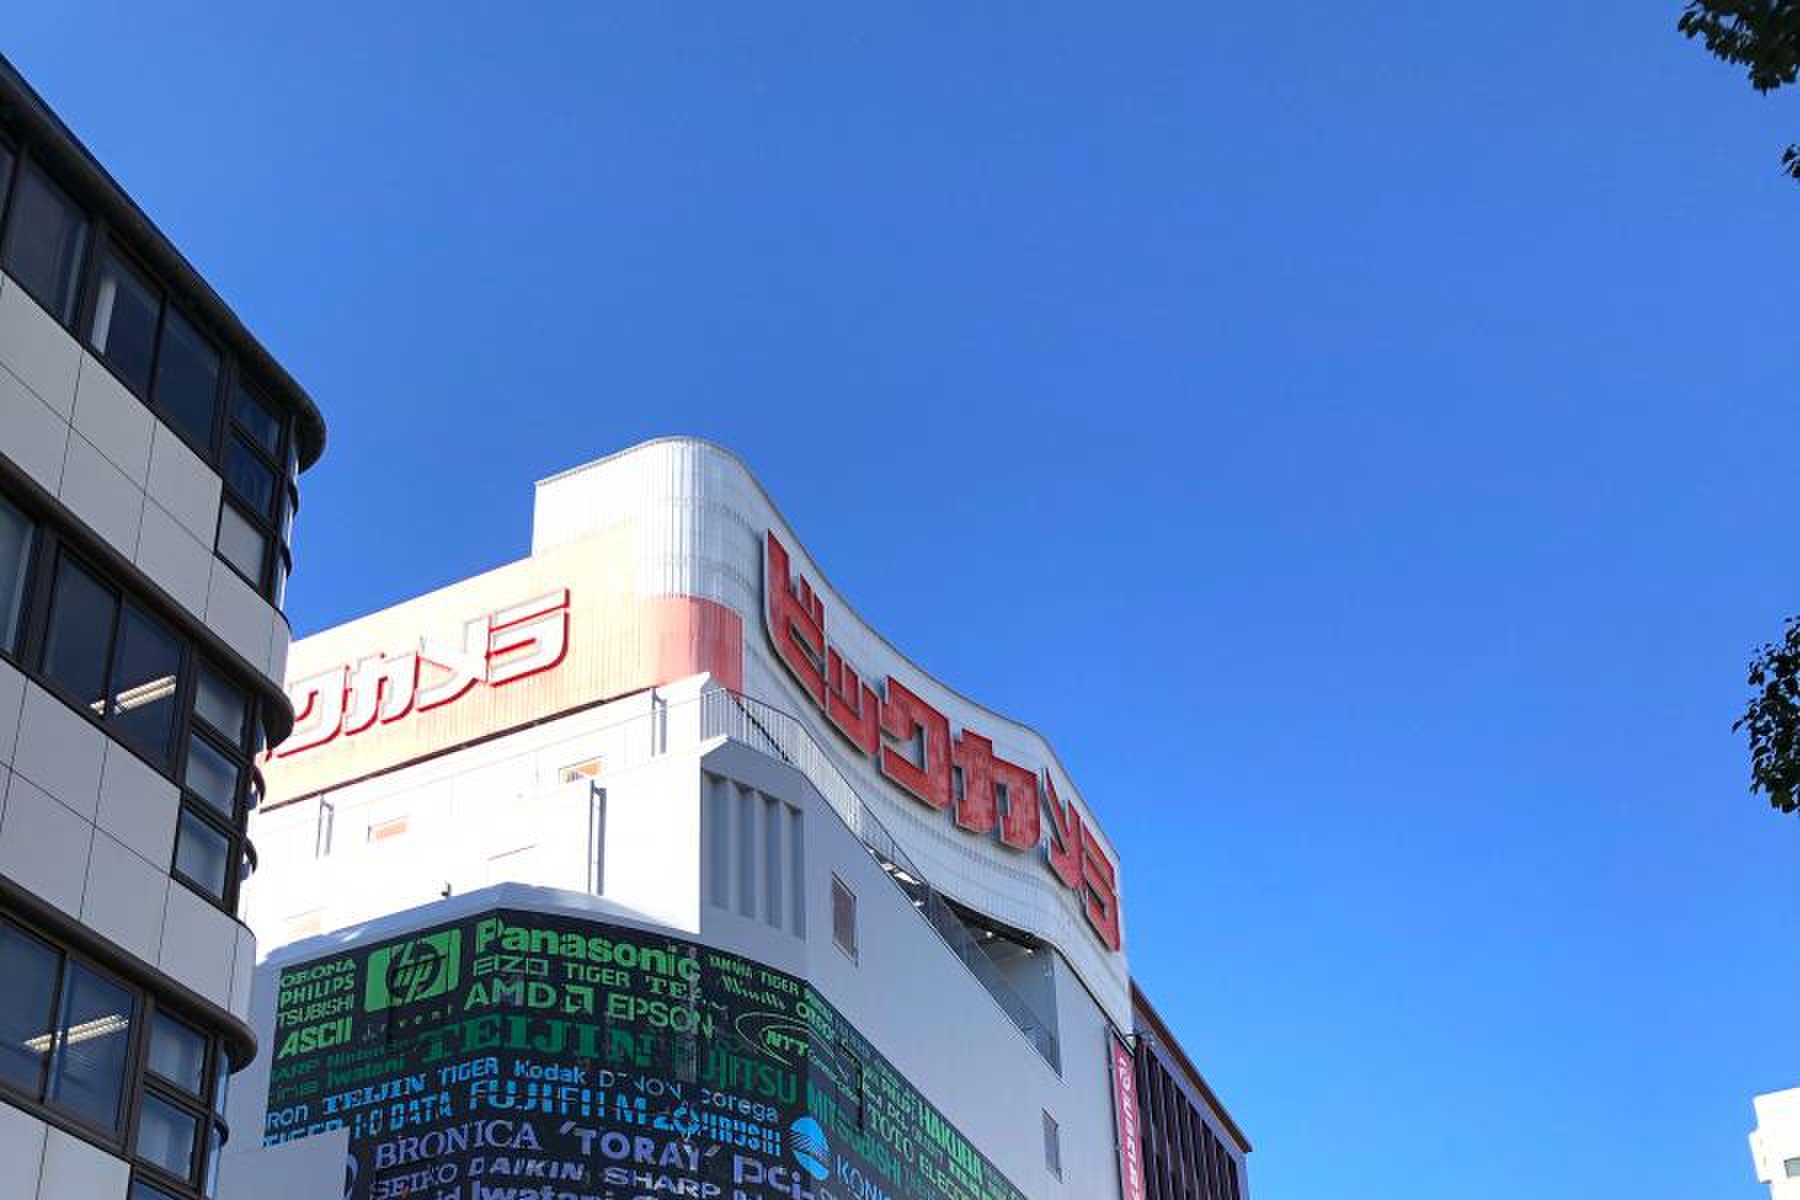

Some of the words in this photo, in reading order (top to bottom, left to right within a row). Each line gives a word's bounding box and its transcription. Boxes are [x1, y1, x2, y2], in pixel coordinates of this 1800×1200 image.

[764, 527, 1120, 952] ビックカメラ
[477, 920, 701, 980] Panasonic
[280, 974, 355, 1008] PHILIPS
[565, 963, 631, 988] TIGER
[464, 980, 556, 1012] AMD
[607, 990, 714, 1040] EPSON
[277, 1016, 352, 1059] ASCII
[437, 1056, 499, 1085] TIGER
[513, 1060, 586, 1085] Kodak
[375, 1117, 543, 1170] BRONICA
[560, 1120, 722, 1172] TORAY
[604, 1167, 722, 1200] SHARP
